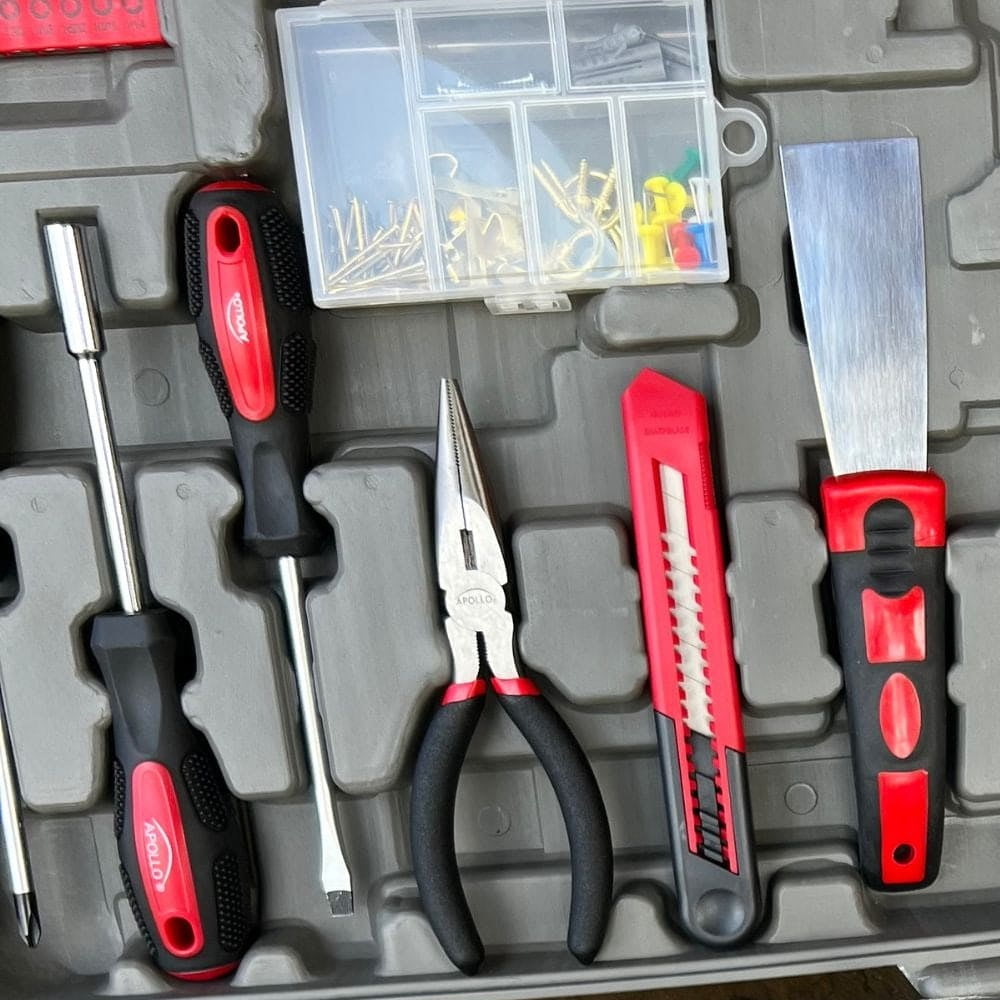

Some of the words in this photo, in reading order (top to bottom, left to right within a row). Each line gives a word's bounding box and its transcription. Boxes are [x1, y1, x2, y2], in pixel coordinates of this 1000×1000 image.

[232, 298, 250, 343] APOLLO
[456, 595, 492, 606] APOLLO
[144, 822, 164, 880] APOLLO
